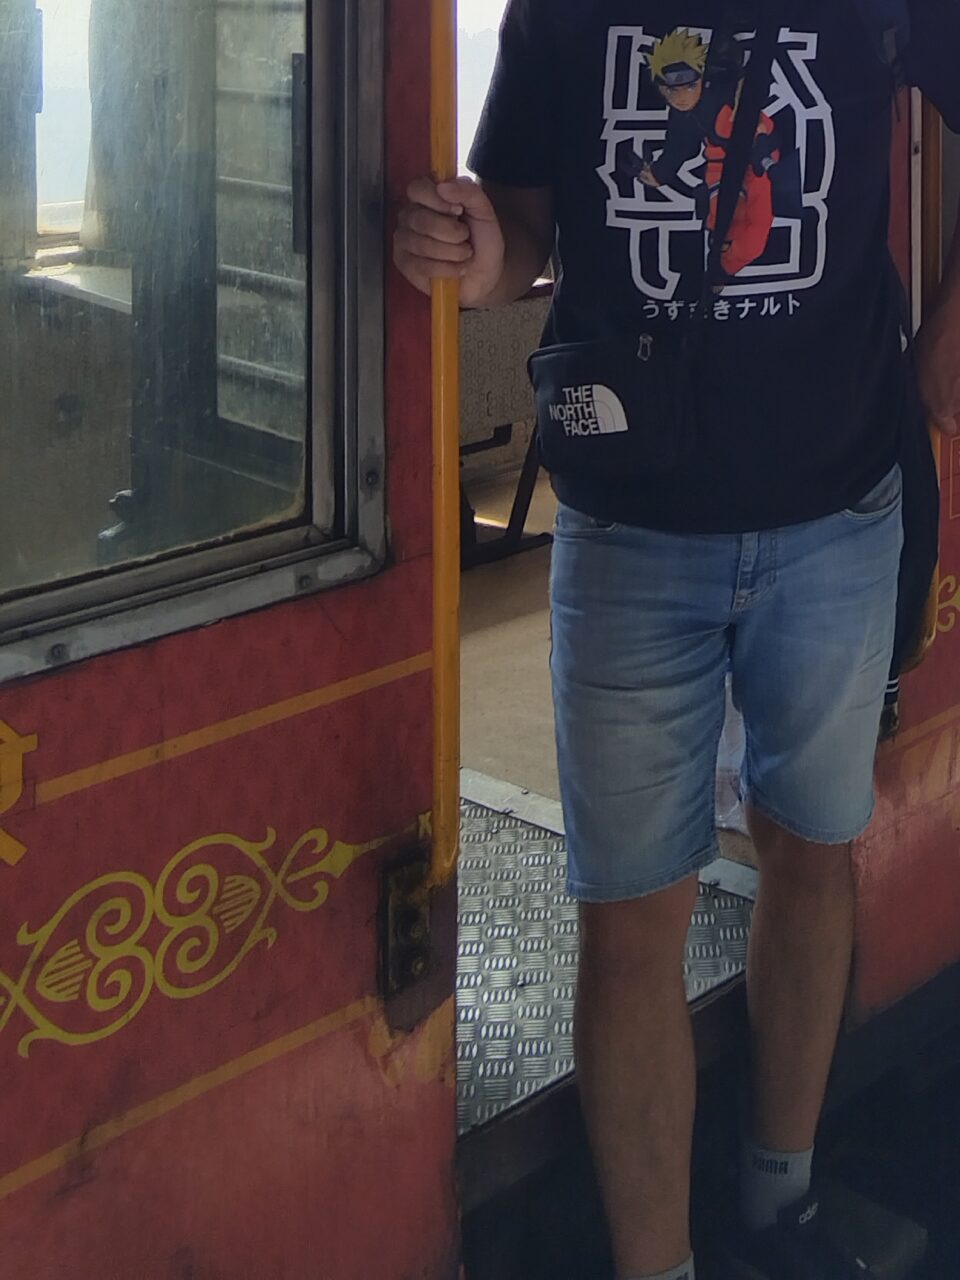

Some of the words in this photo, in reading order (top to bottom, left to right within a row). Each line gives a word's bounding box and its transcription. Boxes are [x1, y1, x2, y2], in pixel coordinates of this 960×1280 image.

[562, 385, 592, 404] THE
[549, 401, 596, 422] NORTH
[563, 418, 600, 437] FACE
